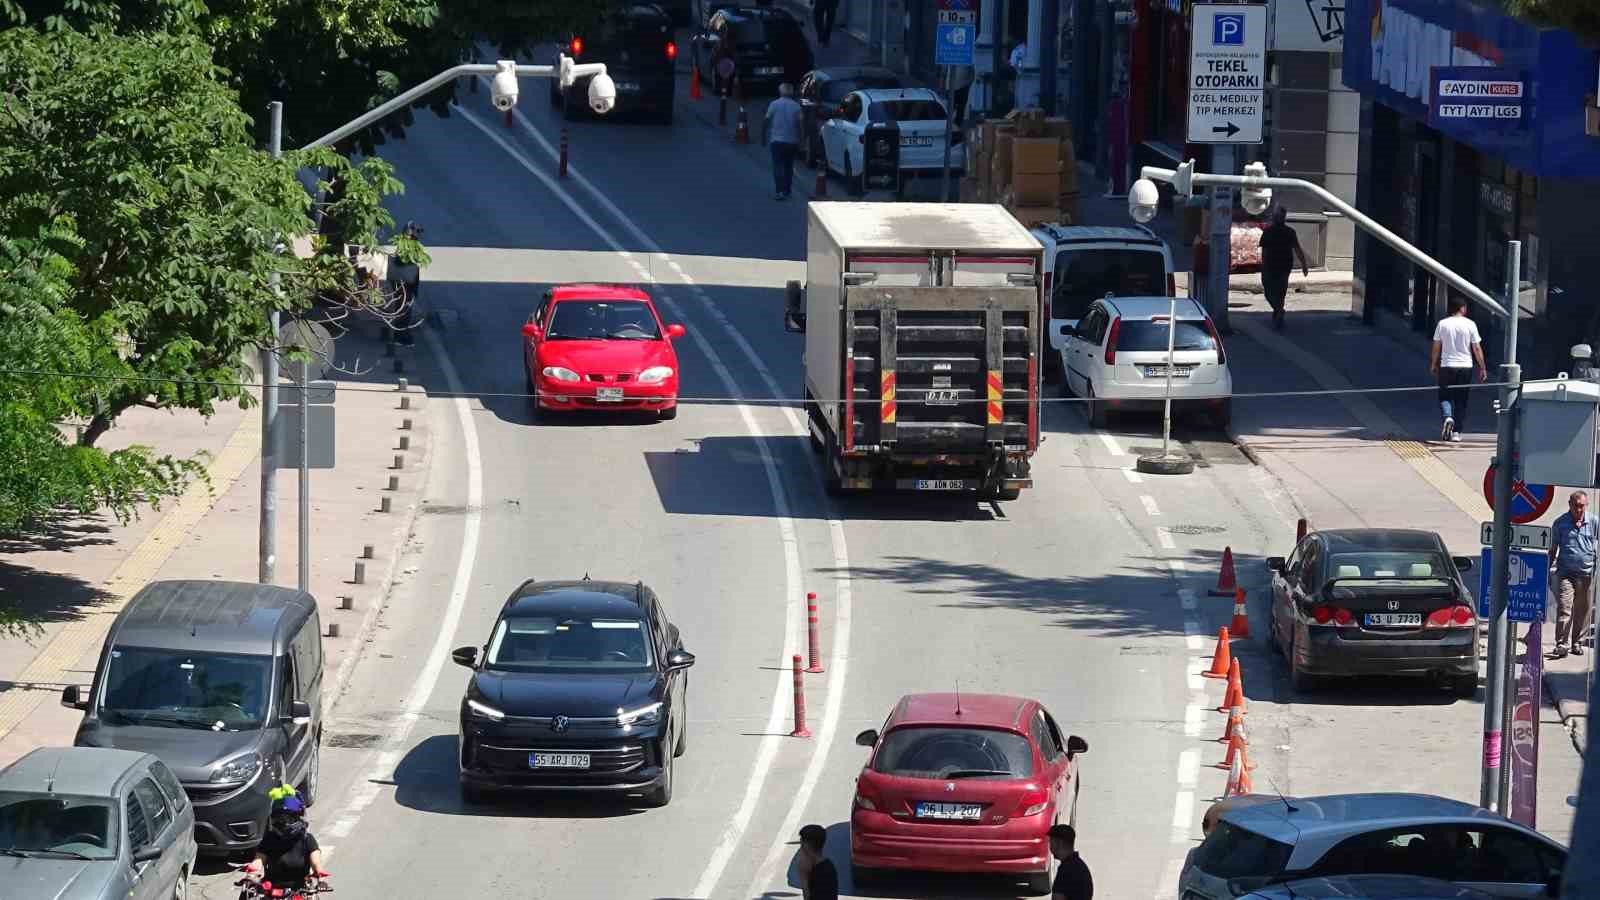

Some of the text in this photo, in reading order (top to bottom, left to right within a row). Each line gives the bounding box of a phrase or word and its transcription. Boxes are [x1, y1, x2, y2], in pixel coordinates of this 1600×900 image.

[1207, 60, 1248, 73] TEKEL
[1195, 74, 1259, 88] OTOPARKI
[1451, 83, 1516, 95] AYDIN KURS
[1195, 106, 1211, 116] TIP
[1442, 106, 1519, 117] TYT AYT LGS
[920, 480, 929, 489] 55
[1520, 535, 1530, 545] m
[1371, 614, 1420, 624] 43 U 7723
[535, 754, 545, 766] 55
[551, 754, 568, 766] ARJ
[961, 805, 981, 817] 207
